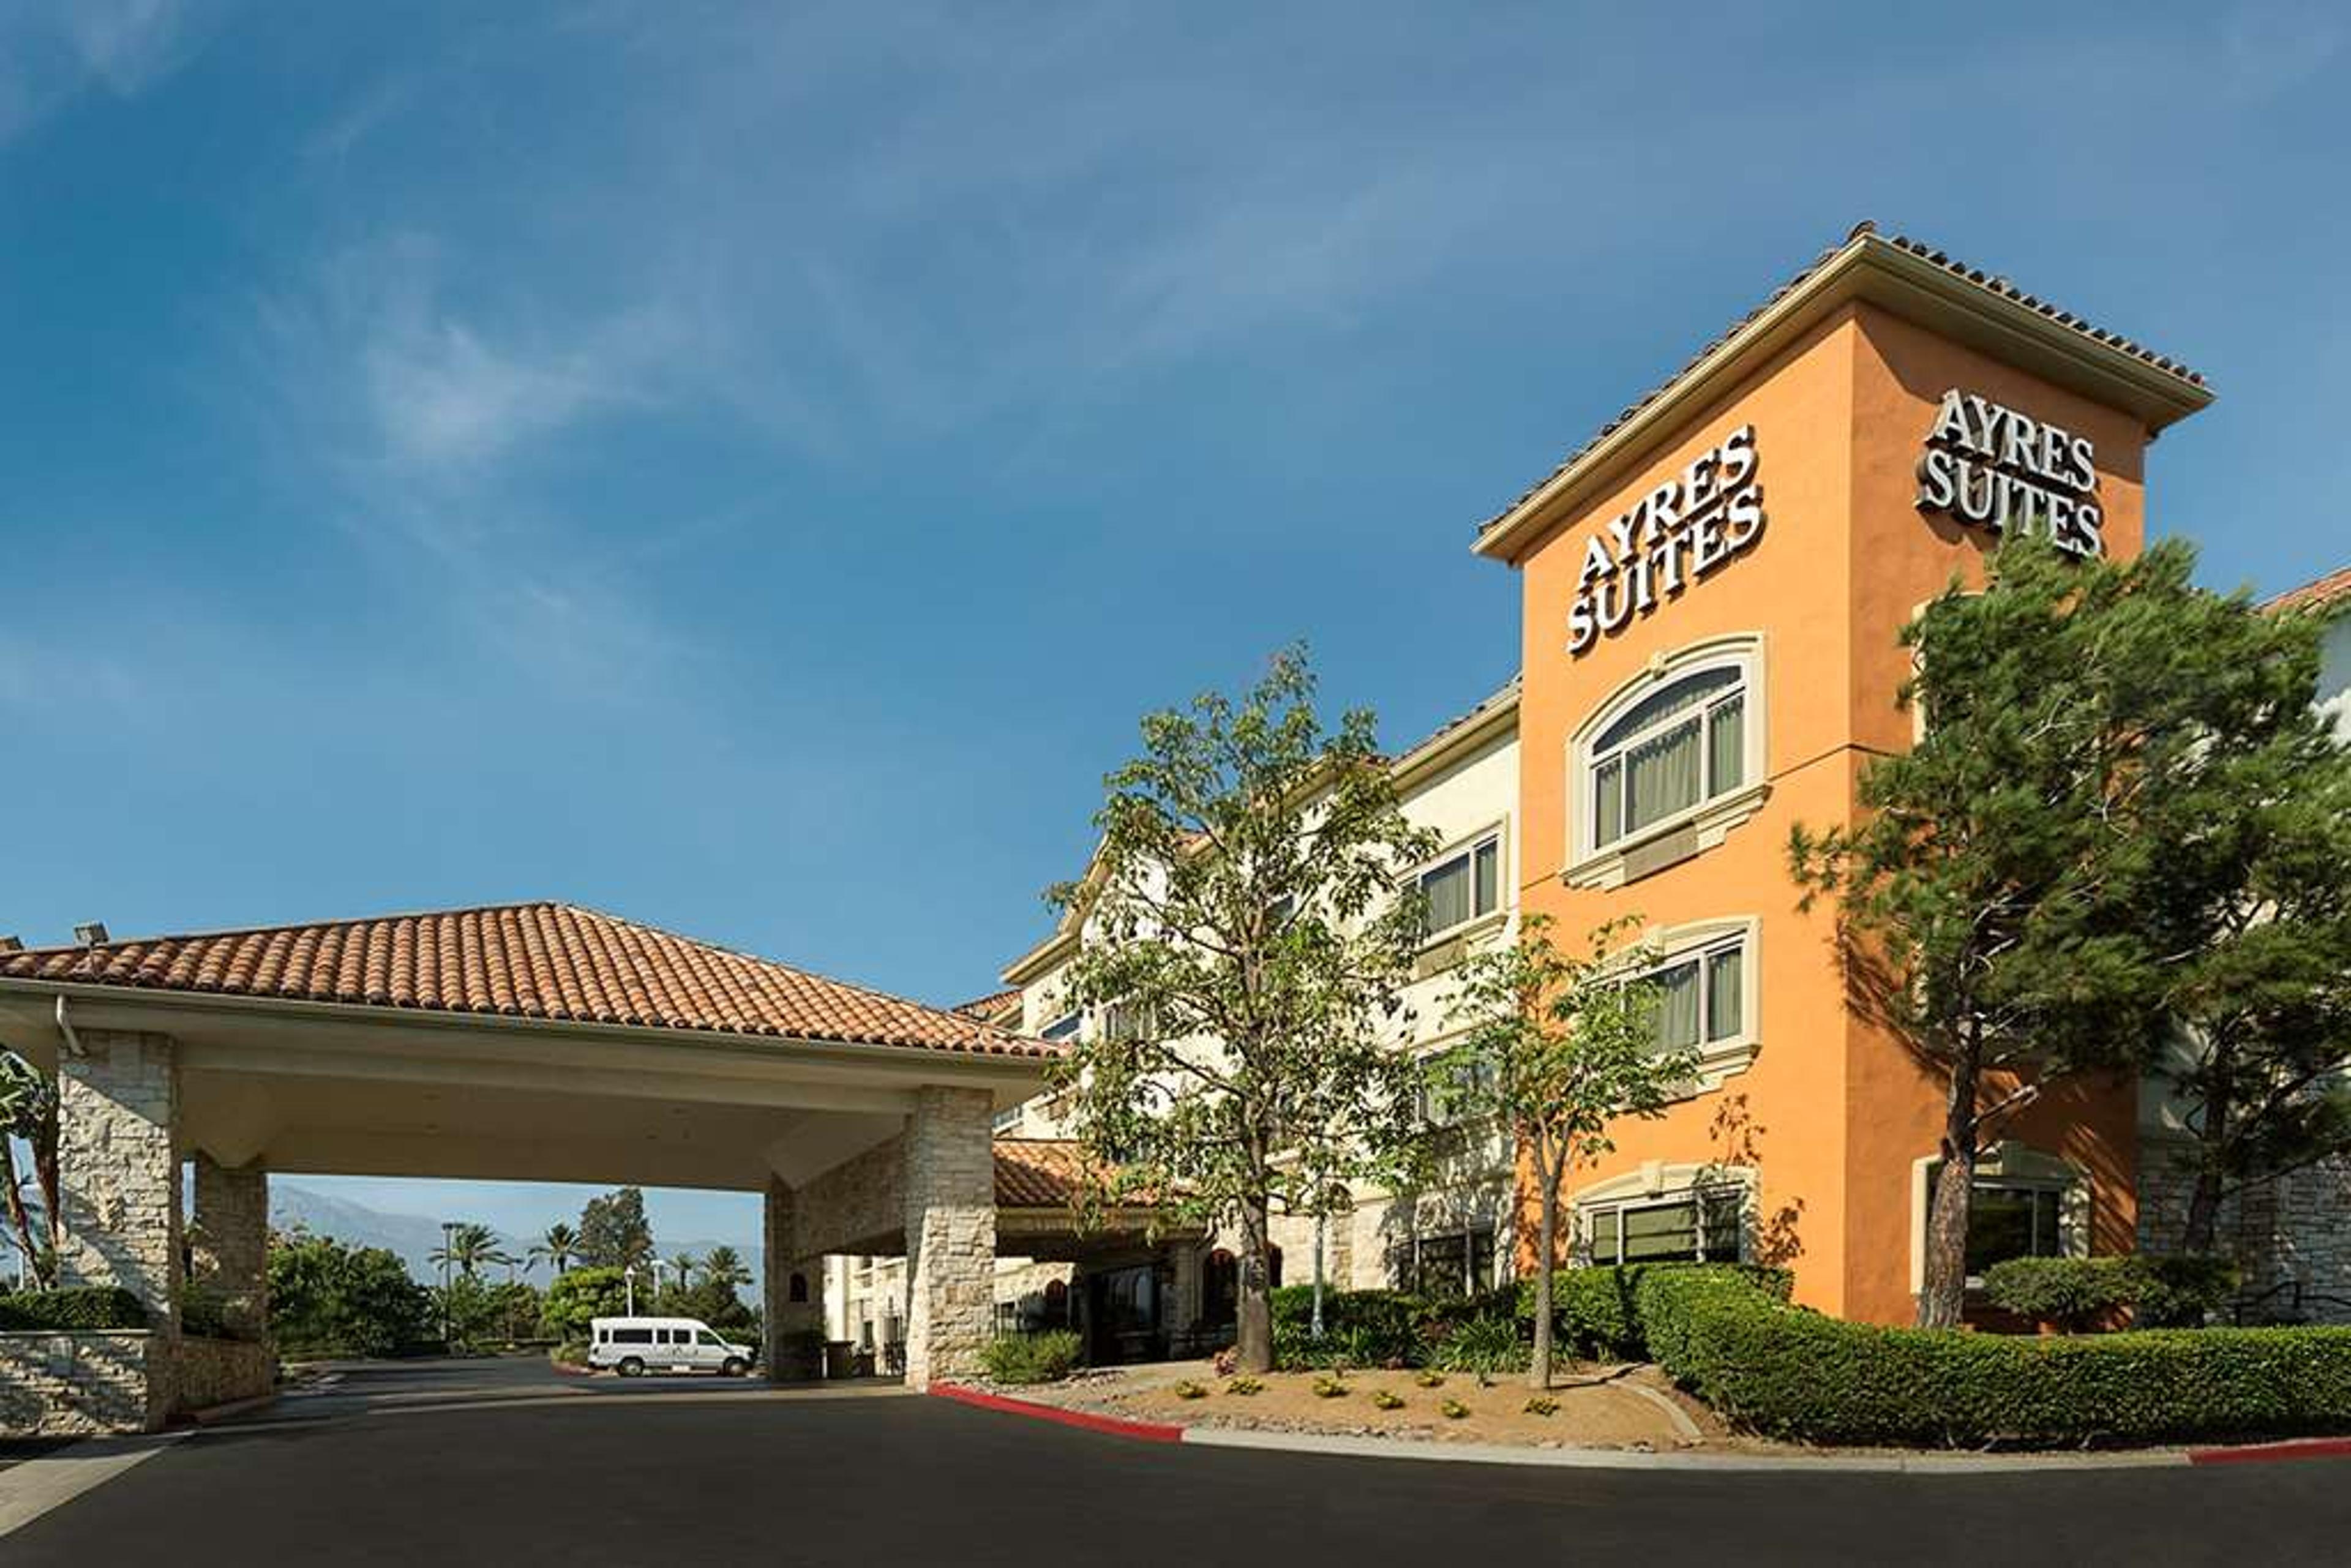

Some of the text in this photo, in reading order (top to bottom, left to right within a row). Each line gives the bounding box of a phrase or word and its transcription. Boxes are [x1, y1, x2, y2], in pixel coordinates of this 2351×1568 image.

[1578, 424, 1755, 589] AYRES
[1919, 449, 2101, 557] SUITES
[1924, 388, 2094, 492] AYRES
[1567, 487, 1763, 655] SUITES
